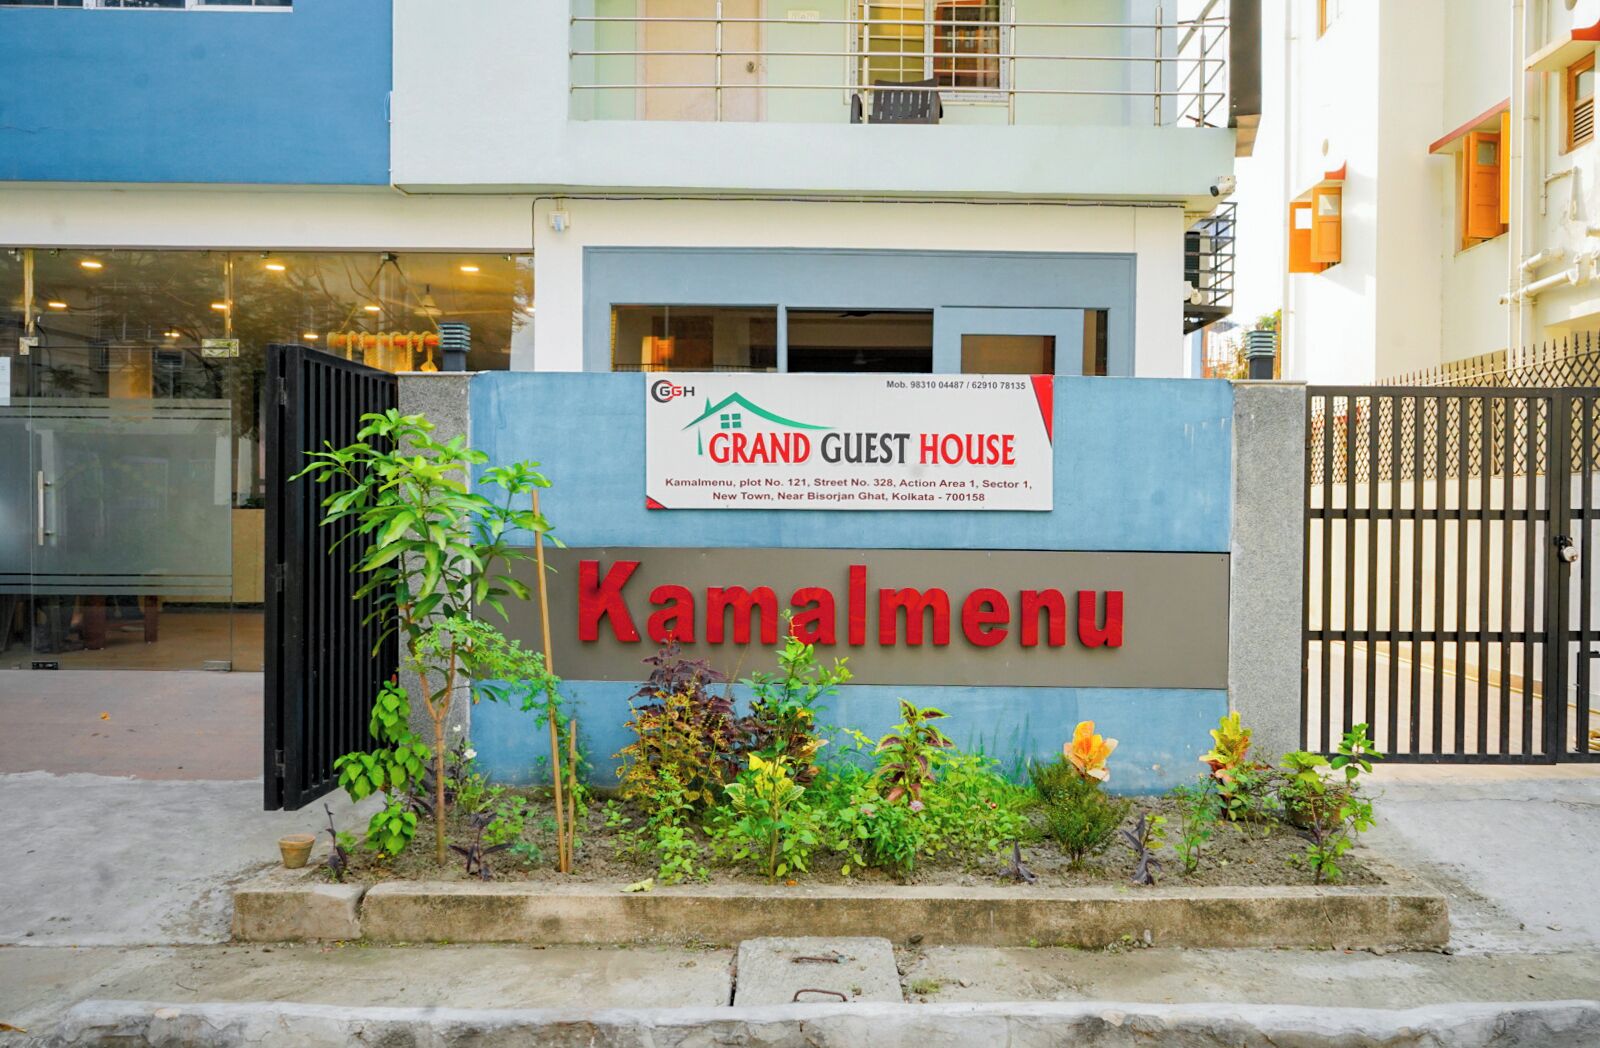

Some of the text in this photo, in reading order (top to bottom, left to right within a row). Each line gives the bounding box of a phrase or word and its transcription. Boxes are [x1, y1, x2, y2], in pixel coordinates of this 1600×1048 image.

[886, 380, 908, 389] Mob.
[910, 380, 936, 389] 98310
[938, 380, 964, 389] 04487
[971, 380, 998, 389] 62910
[1000, 381, 1026, 390] 78135
[708, 432, 1015, 466] GRAND GUEST HOUSE
[665, 478, 1032, 490] Kamalmenu, plot No. 121, Street No. 328, Action Area 1, Sector 1,
[712, 491, 737, 501] New
[741, 491, 774, 501] Town,
[777, 491, 803, 501] Near
[807, 491, 855, 502] Bisorjan
[858, 491, 888, 501] Ghat,
[891, 492, 935, 502] Kolkata
[945, 492, 985, 502] 700158
[578, 560, 1124, 648] Kamalmenu
